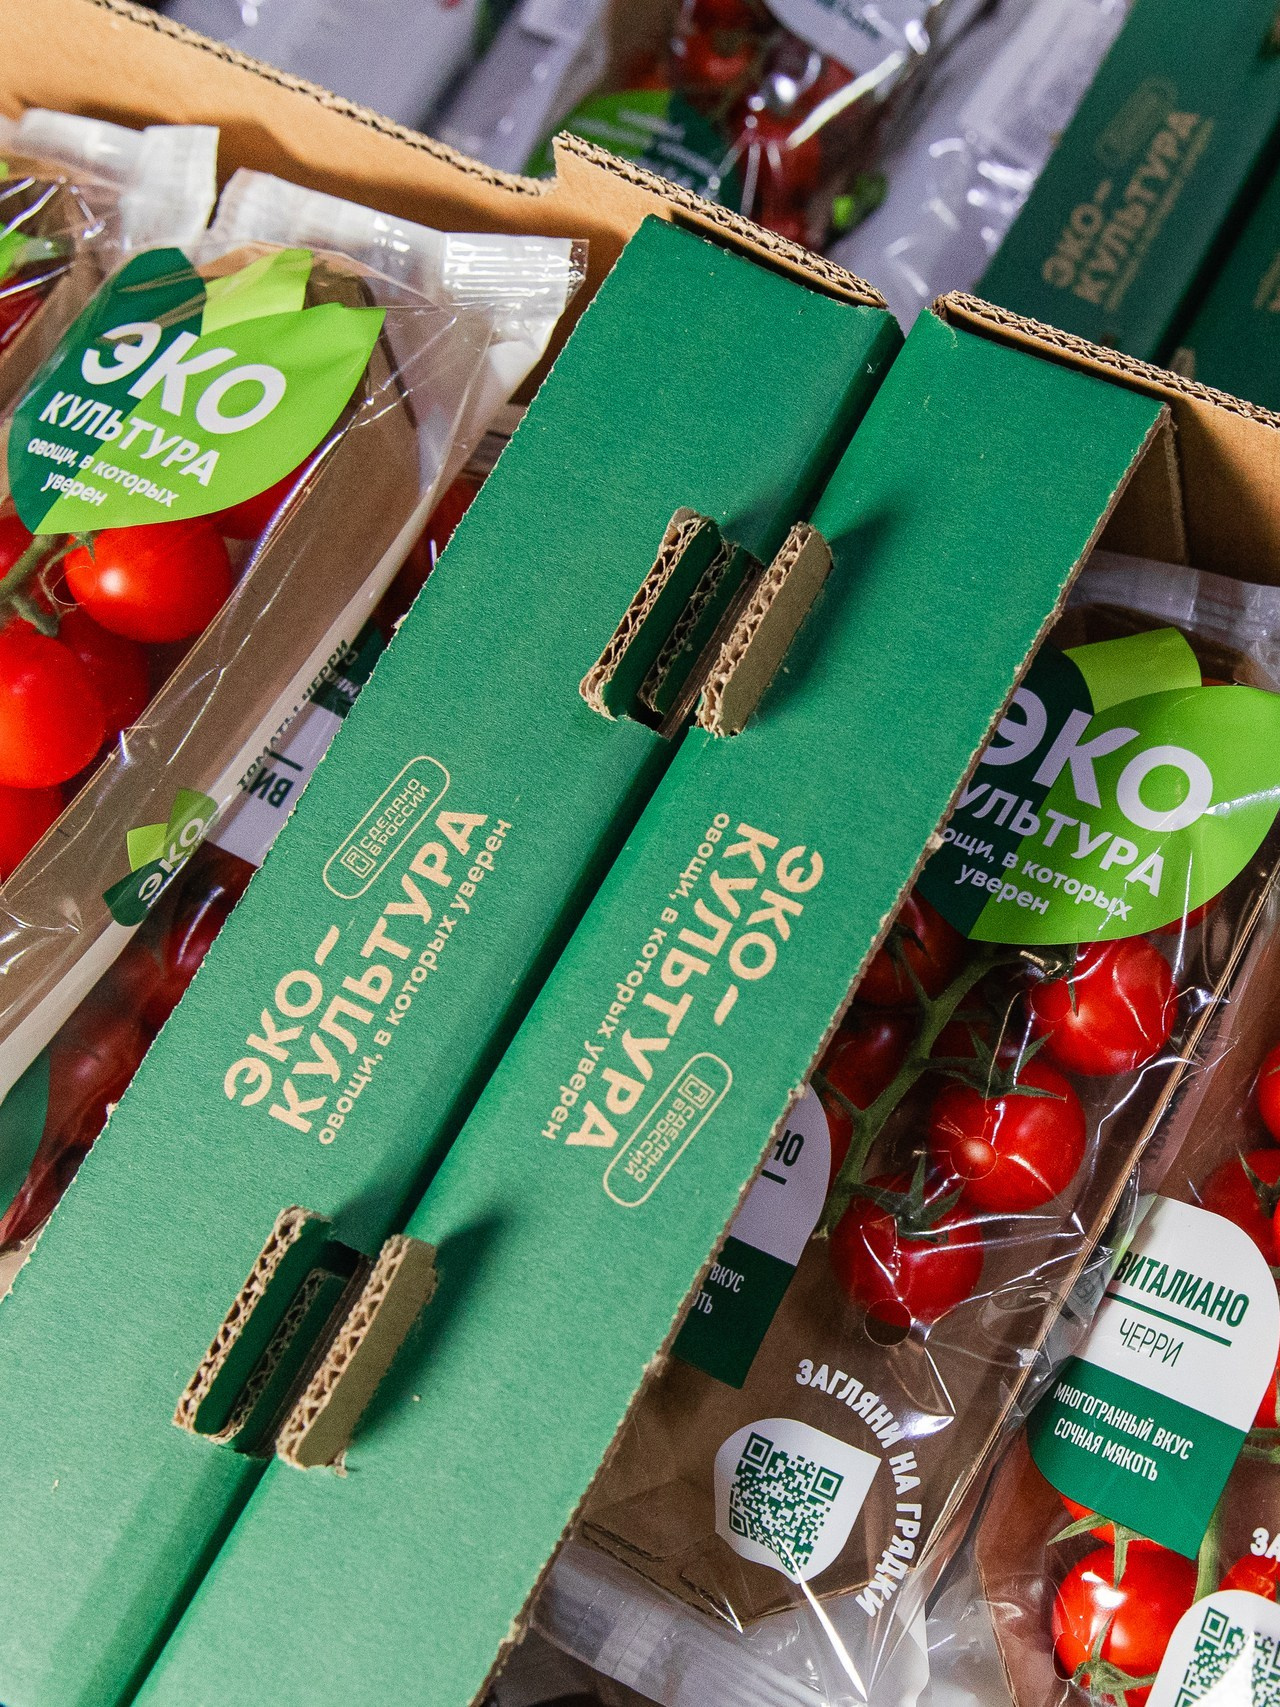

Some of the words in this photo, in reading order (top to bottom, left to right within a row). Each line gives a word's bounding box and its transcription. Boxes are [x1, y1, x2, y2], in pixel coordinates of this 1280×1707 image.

[1072, 111, 1202, 304] КУЛЬТУРА
[80, 321, 287, 435] ЭКО
[27, 438, 80, 468] овощи,
[78, 454, 94, 469] в
[92, 460, 179, 507] которых
[38, 391, 221, 487] КУЛЬТУРА
[40, 472, 108, 507] уверен
[980, 686, 1213, 833] ЭКО
[360, 777, 421, 850] СДЕЛАНО
[371, 845, 382, 857] В
[380, 785, 430, 847] РОССИИ
[955, 783, 1165, 897] УЛЬТУРА
[138, 817, 204, 902] ЭКО
[668, 812, 730, 900] овощи,
[942, 827, 995, 864] ощи,
[1001, 852, 1019, 869] в
[1021, 860, 1133, 920] которых
[954, 864, 1050, 916] уверен
[660, 906, 679, 924] в
[268, 811, 488, 1134] КУЛЬТУРА
[318, 1053, 383, 1145] овощи,
[374, 1029, 392, 1046] в
[386, 914, 458, 1026] которых
[451, 819, 513, 914] уверен
[564, 822, 780, 1148] КУЛЬТУРА
[597, 927, 667, 1039] которых
[541, 1040, 605, 1140] уверен
[672, 1098, 686, 1111] В
[624, 1109, 677, 1176] РОССИИ
[634, 1105, 695, 1183] СДЕЛАНО
[709, 1262, 745, 1293] ВКУС
[1113, 1250, 1251, 1328] ВИТАЛИАНО
[1119, 1317, 1186, 1368] ЧЕРРИ
[795, 1359, 905, 1449] ЗАГЛЯНИ
[1053, 1382, 1155, 1443] МНОГОГРАННЫЙ
[1151, 1427, 1194, 1461] ВКУС
[888, 1451, 922, 1495] НА
[1053, 1417, 1105, 1455] СОЧНАЯ
[1101, 1440, 1159, 1482] МЯКОТЬ
[855, 1503, 922, 1617] ГРЯДКИ
